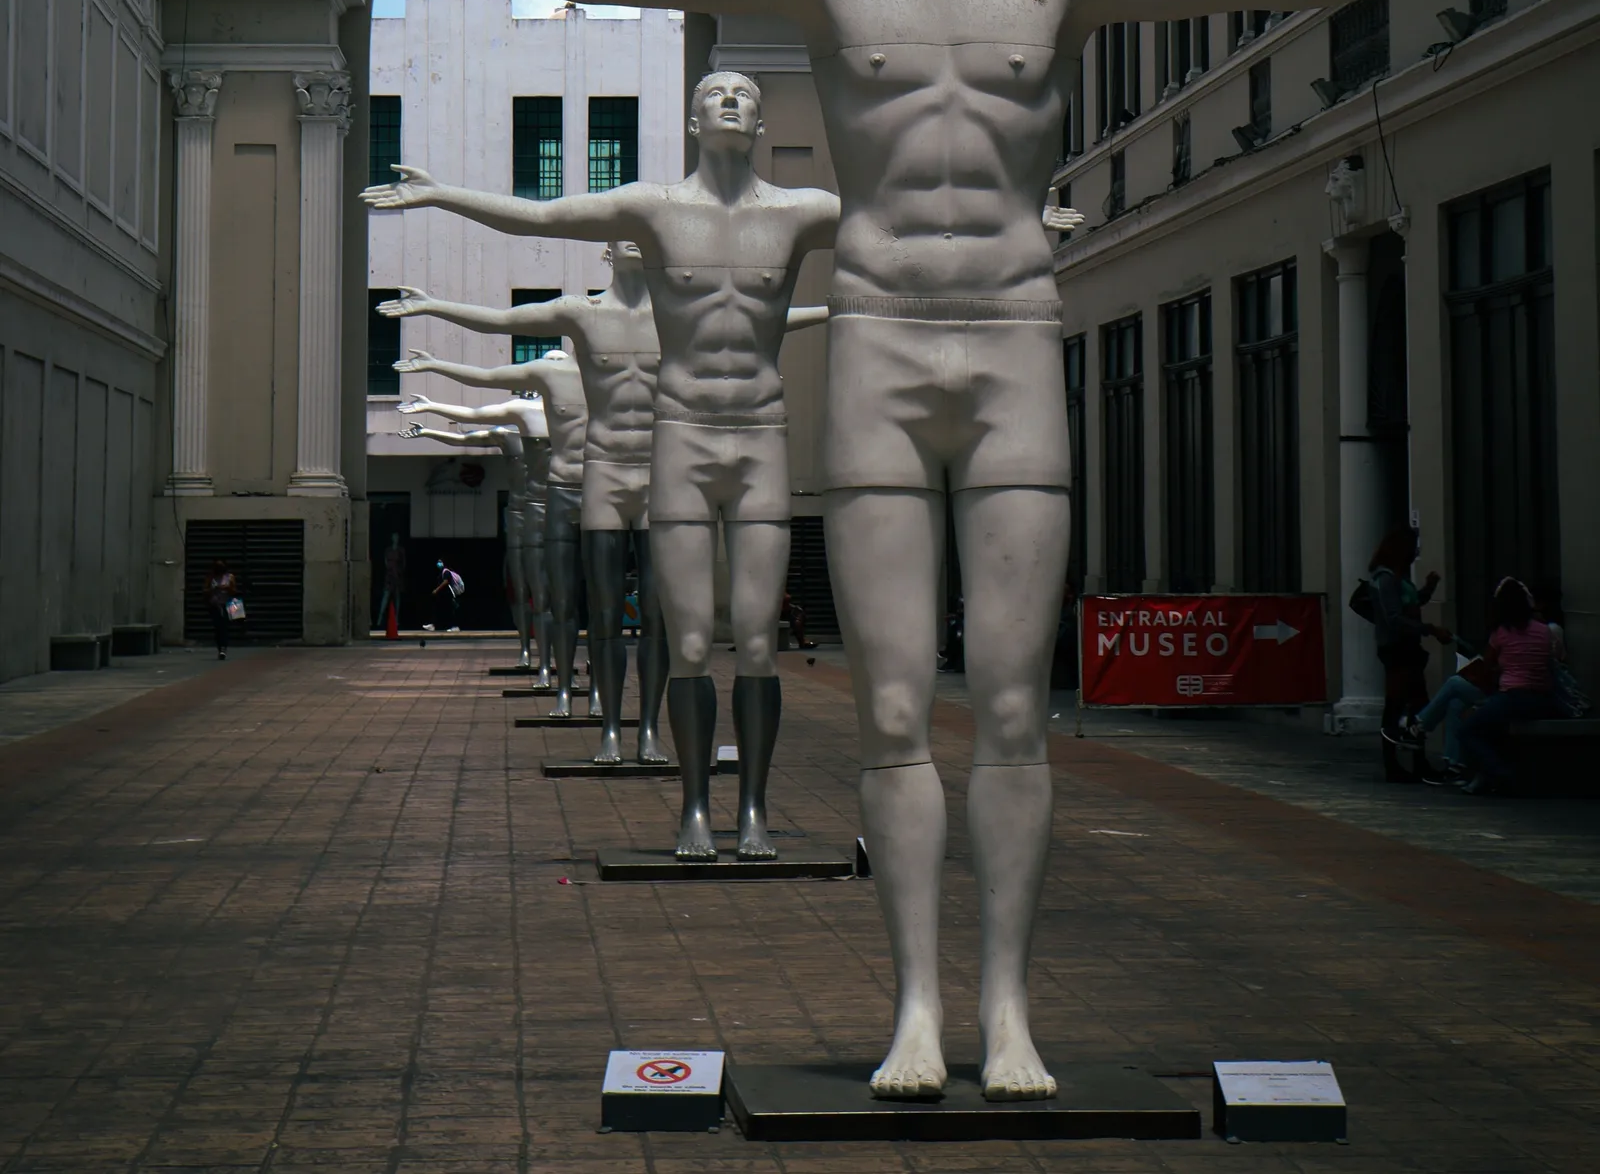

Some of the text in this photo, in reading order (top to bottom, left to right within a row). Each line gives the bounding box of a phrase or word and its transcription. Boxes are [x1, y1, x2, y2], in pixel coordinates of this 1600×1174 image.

[1097, 611, 1229, 627] ENTRADA AL
[1097, 632, 1229, 657] MUSEO
